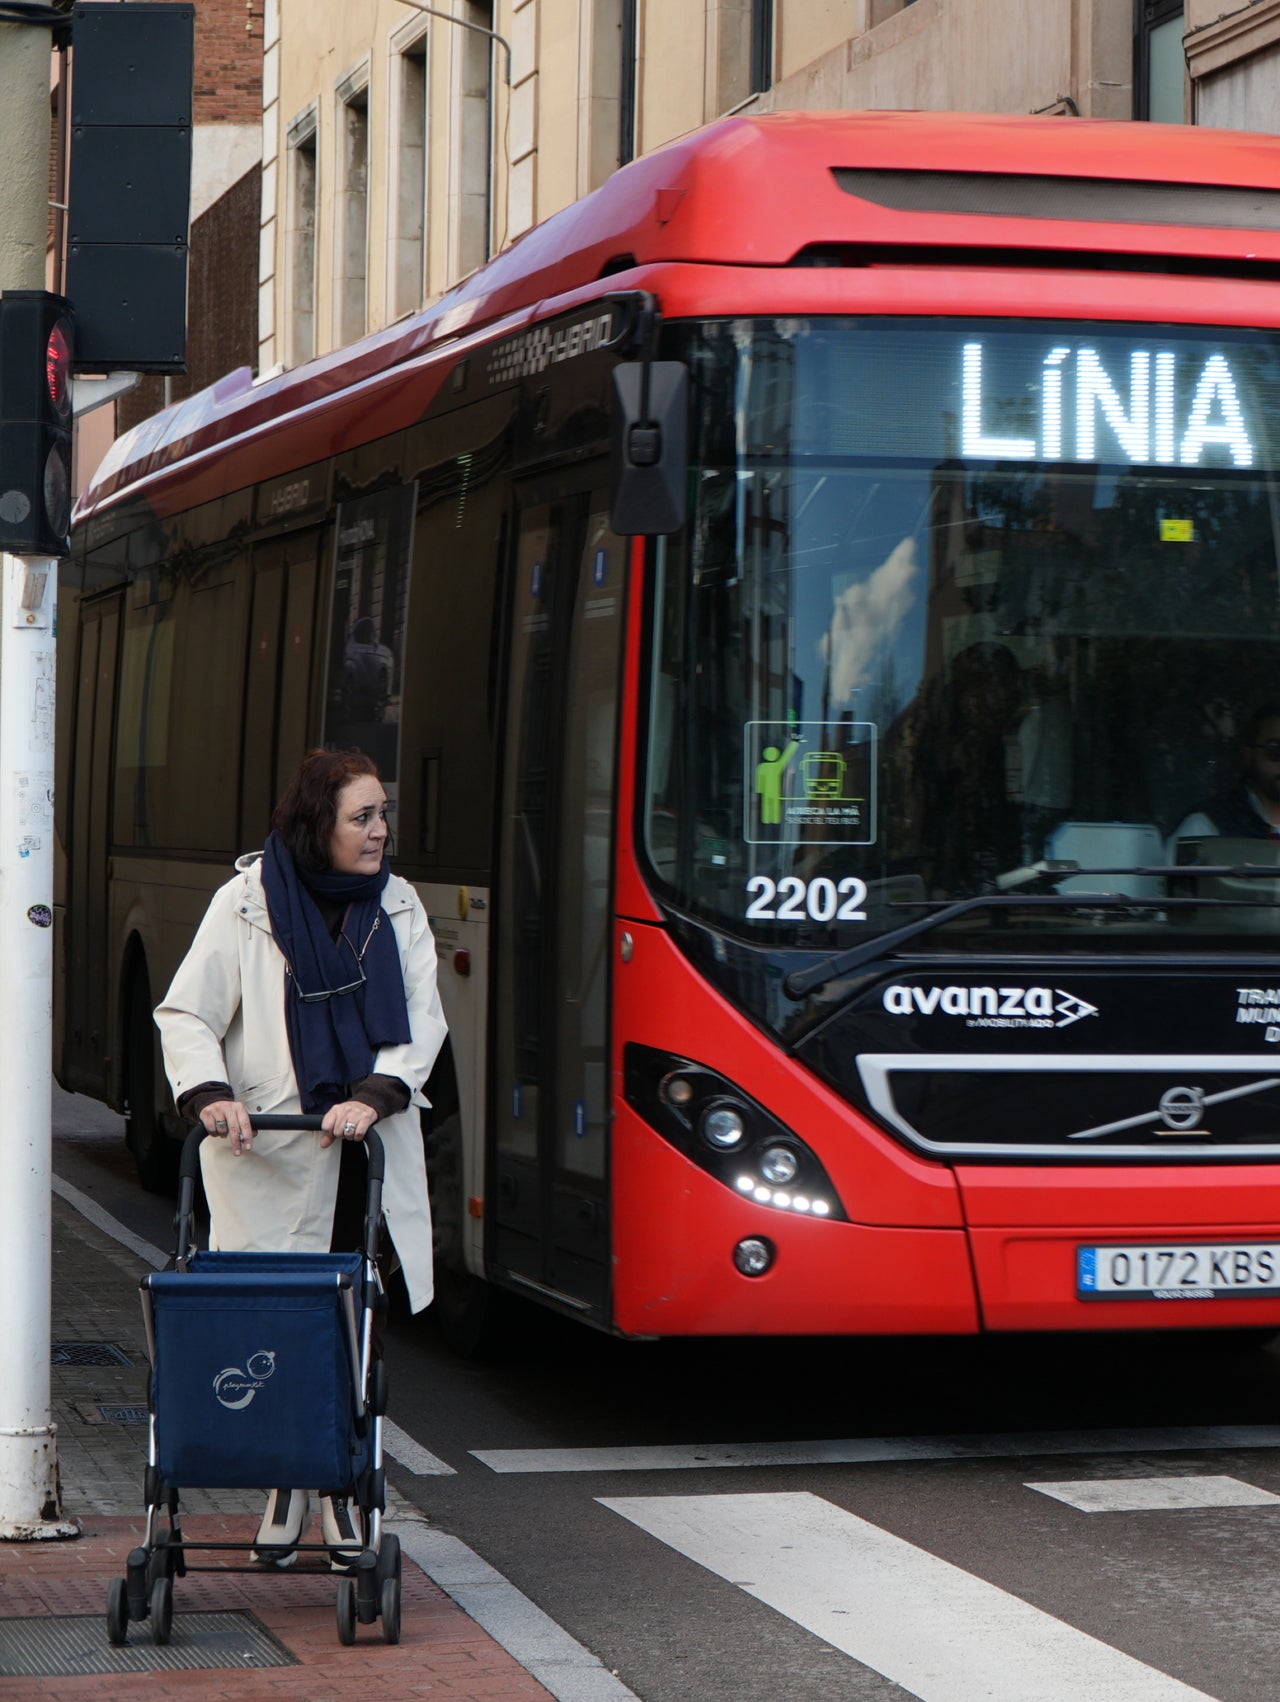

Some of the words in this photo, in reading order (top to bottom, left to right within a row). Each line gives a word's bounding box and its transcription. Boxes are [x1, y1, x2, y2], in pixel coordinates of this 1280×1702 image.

[962, 343, 1253, 466] LÍNIA
[745, 876, 867, 921] 2202
[883, 985, 1055, 1016] avanza
[1111, 1251, 1200, 1287] 0172
[1209, 1250, 1276, 1285] KBS
